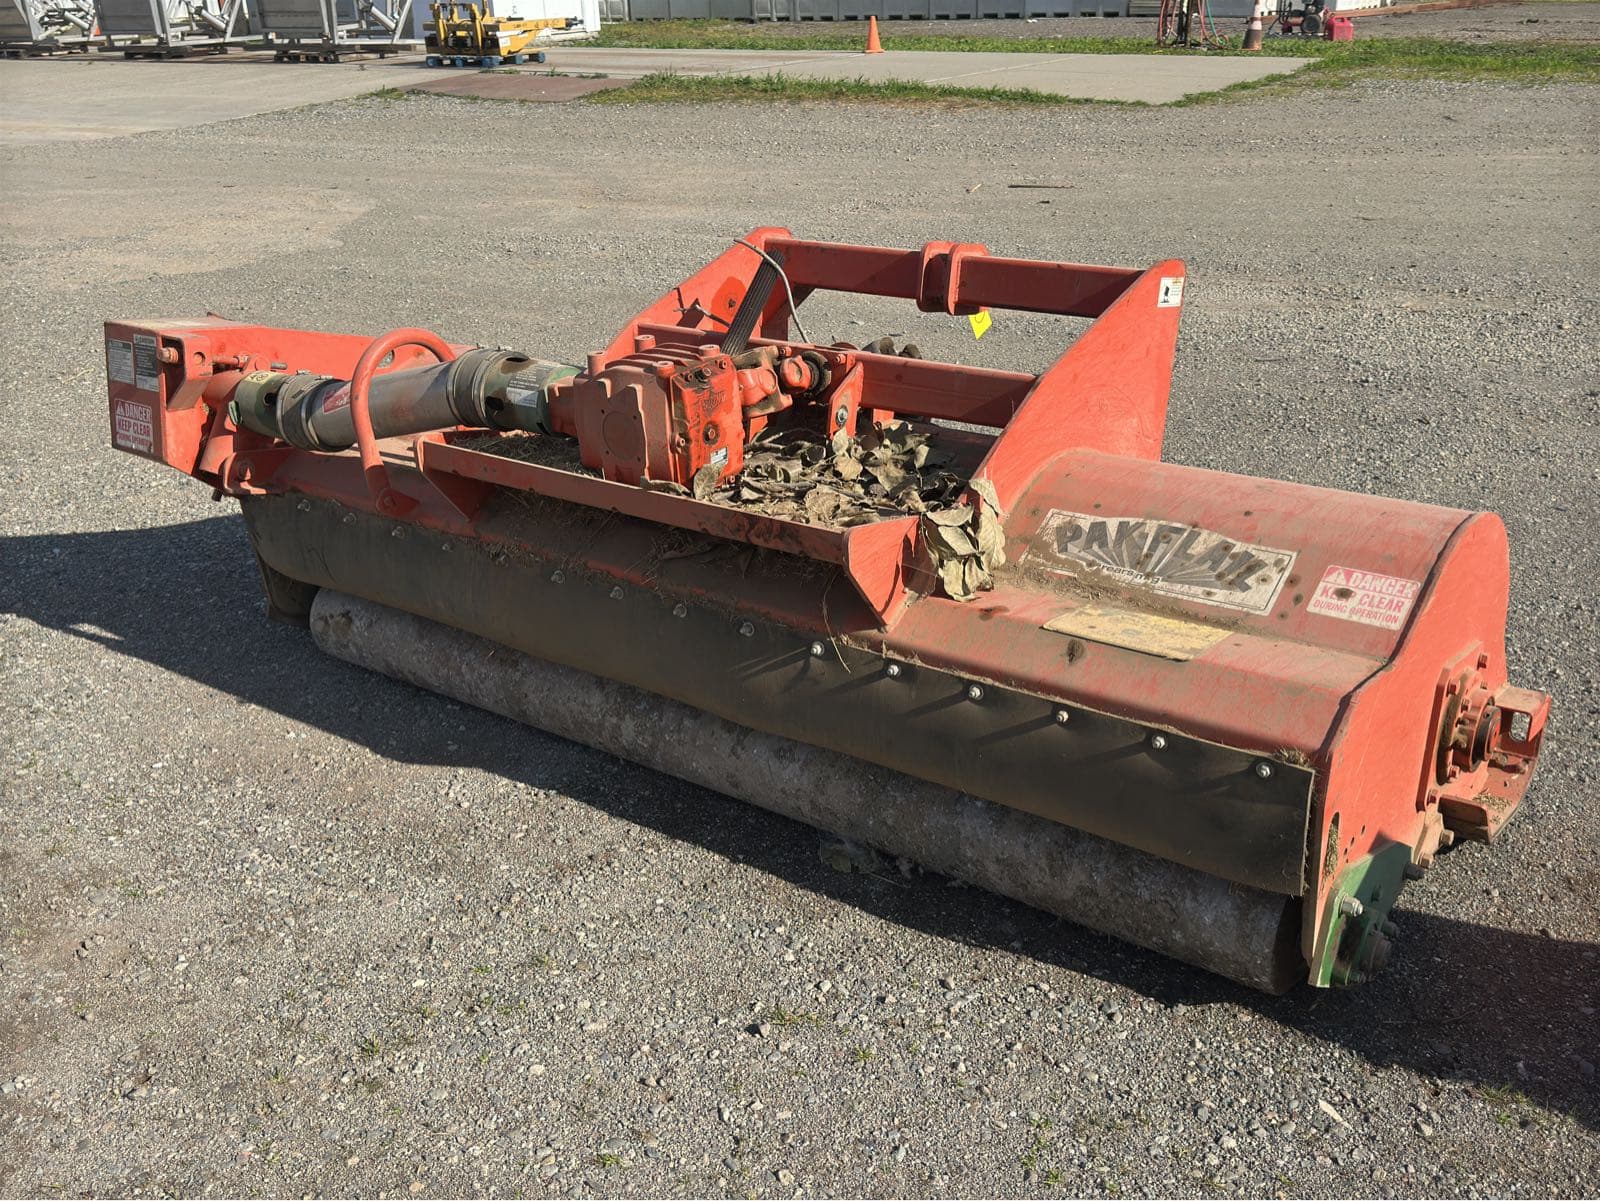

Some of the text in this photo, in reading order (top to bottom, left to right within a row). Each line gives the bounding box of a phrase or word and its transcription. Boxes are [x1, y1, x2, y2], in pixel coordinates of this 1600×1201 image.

[125, 403, 150, 421] DANGER
[1350, 571, 1418, 598] DANGER
[1313, 600, 1399, 623] DURING OPERATION
[1360, 593, 1405, 613] CLEAR
